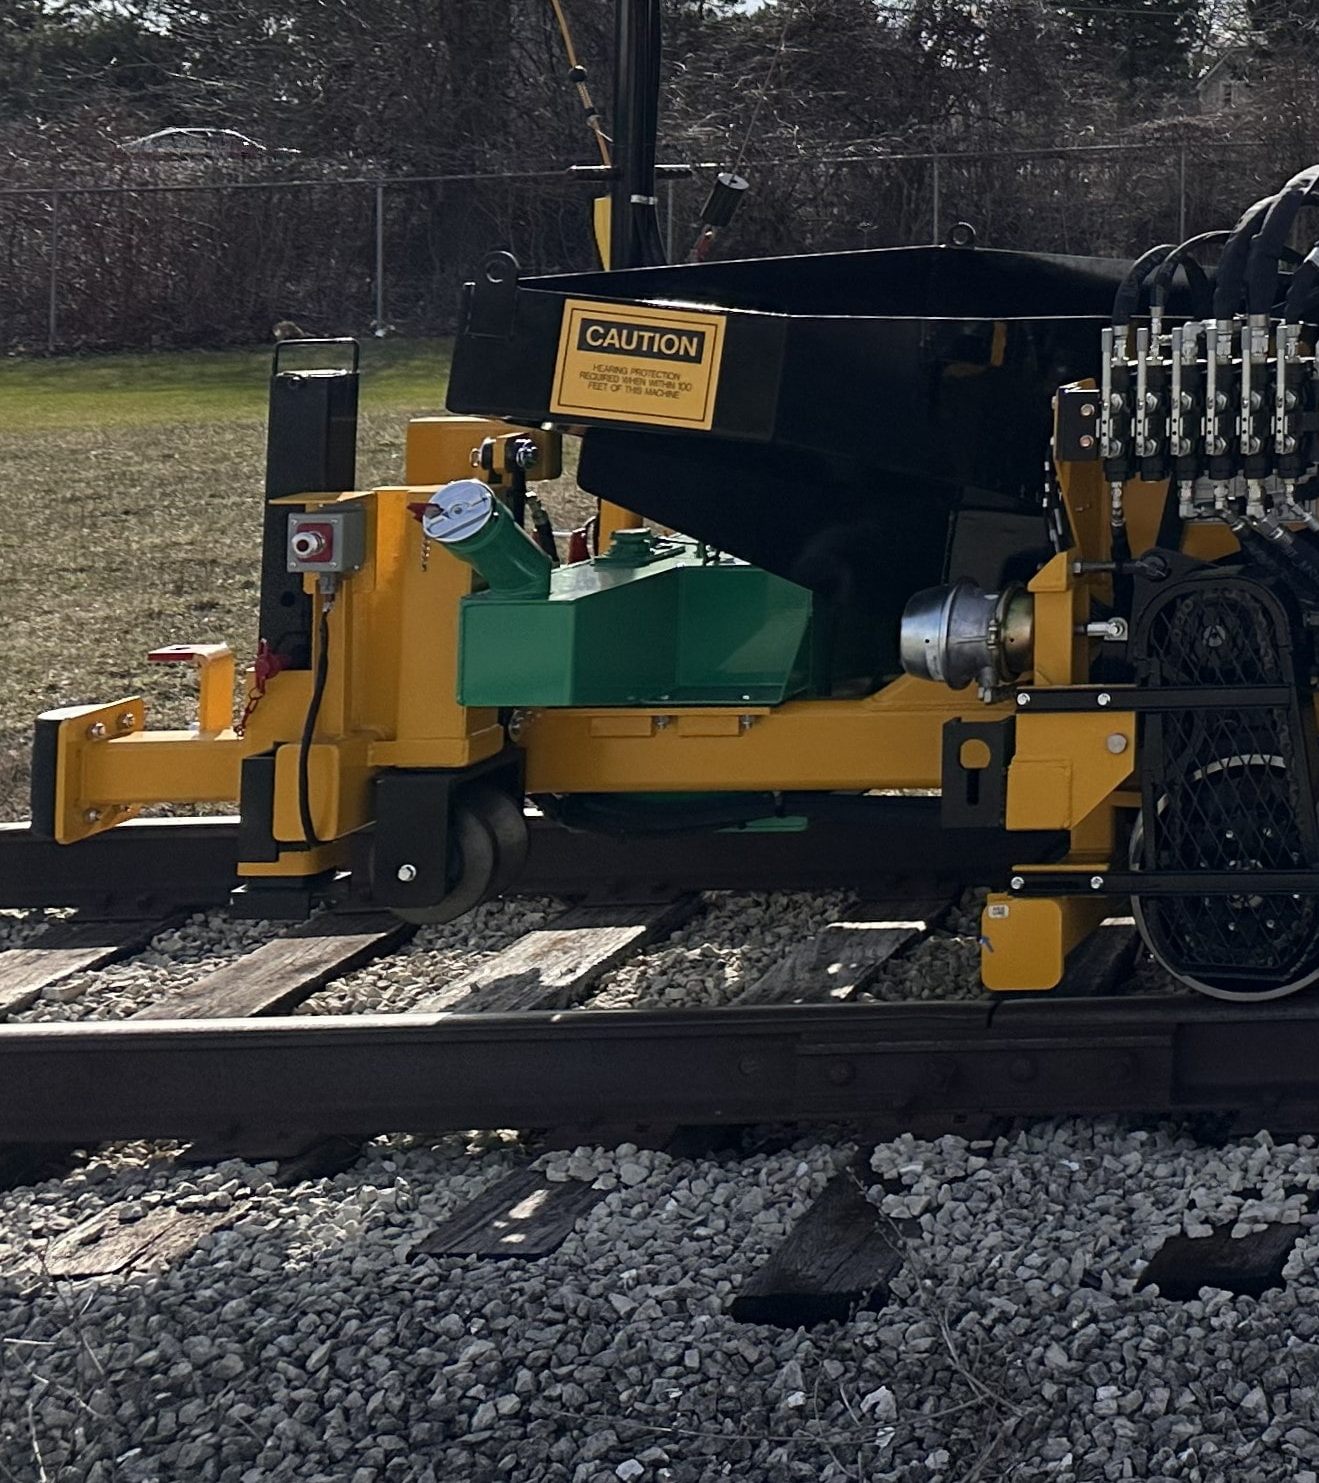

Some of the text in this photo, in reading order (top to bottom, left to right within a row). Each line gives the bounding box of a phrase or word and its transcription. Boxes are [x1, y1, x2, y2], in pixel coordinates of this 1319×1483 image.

[586, 325, 699, 357] CAUTION
[579, 371, 692, 392] REQUIRED WHEN WITHIN 100
[593, 364, 681, 381] HEARING PROTECTION
[588, 381, 681, 399] FEET OF THIS MACHINE
